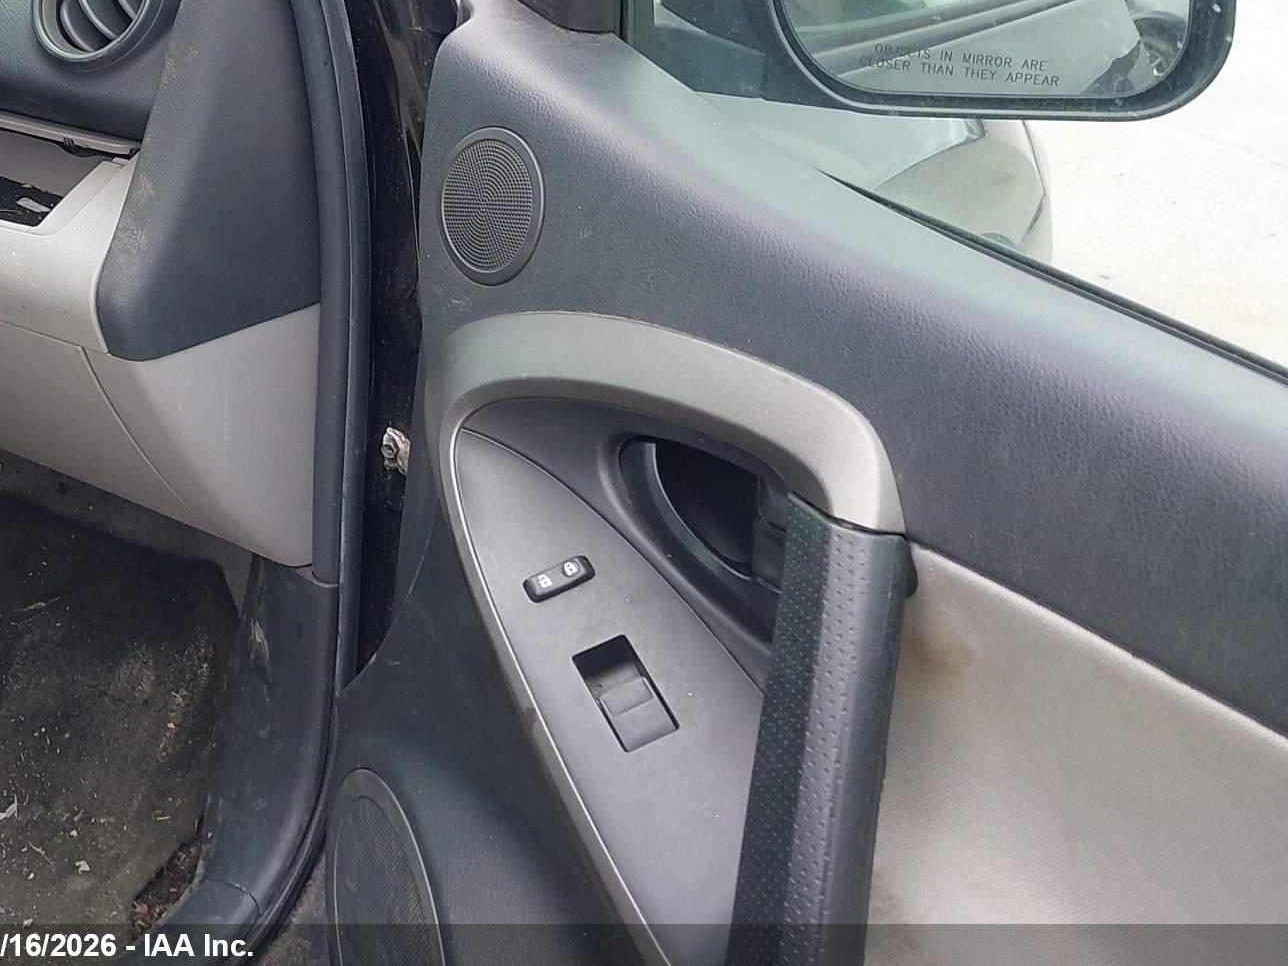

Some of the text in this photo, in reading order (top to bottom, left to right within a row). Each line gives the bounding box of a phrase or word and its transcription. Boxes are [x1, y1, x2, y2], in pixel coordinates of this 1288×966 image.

[859, 56, 1060, 87] CLOSER THAN THEY APPEAR
[874, 43, 1047, 72] OBJECTS IN MIRROR ARE
